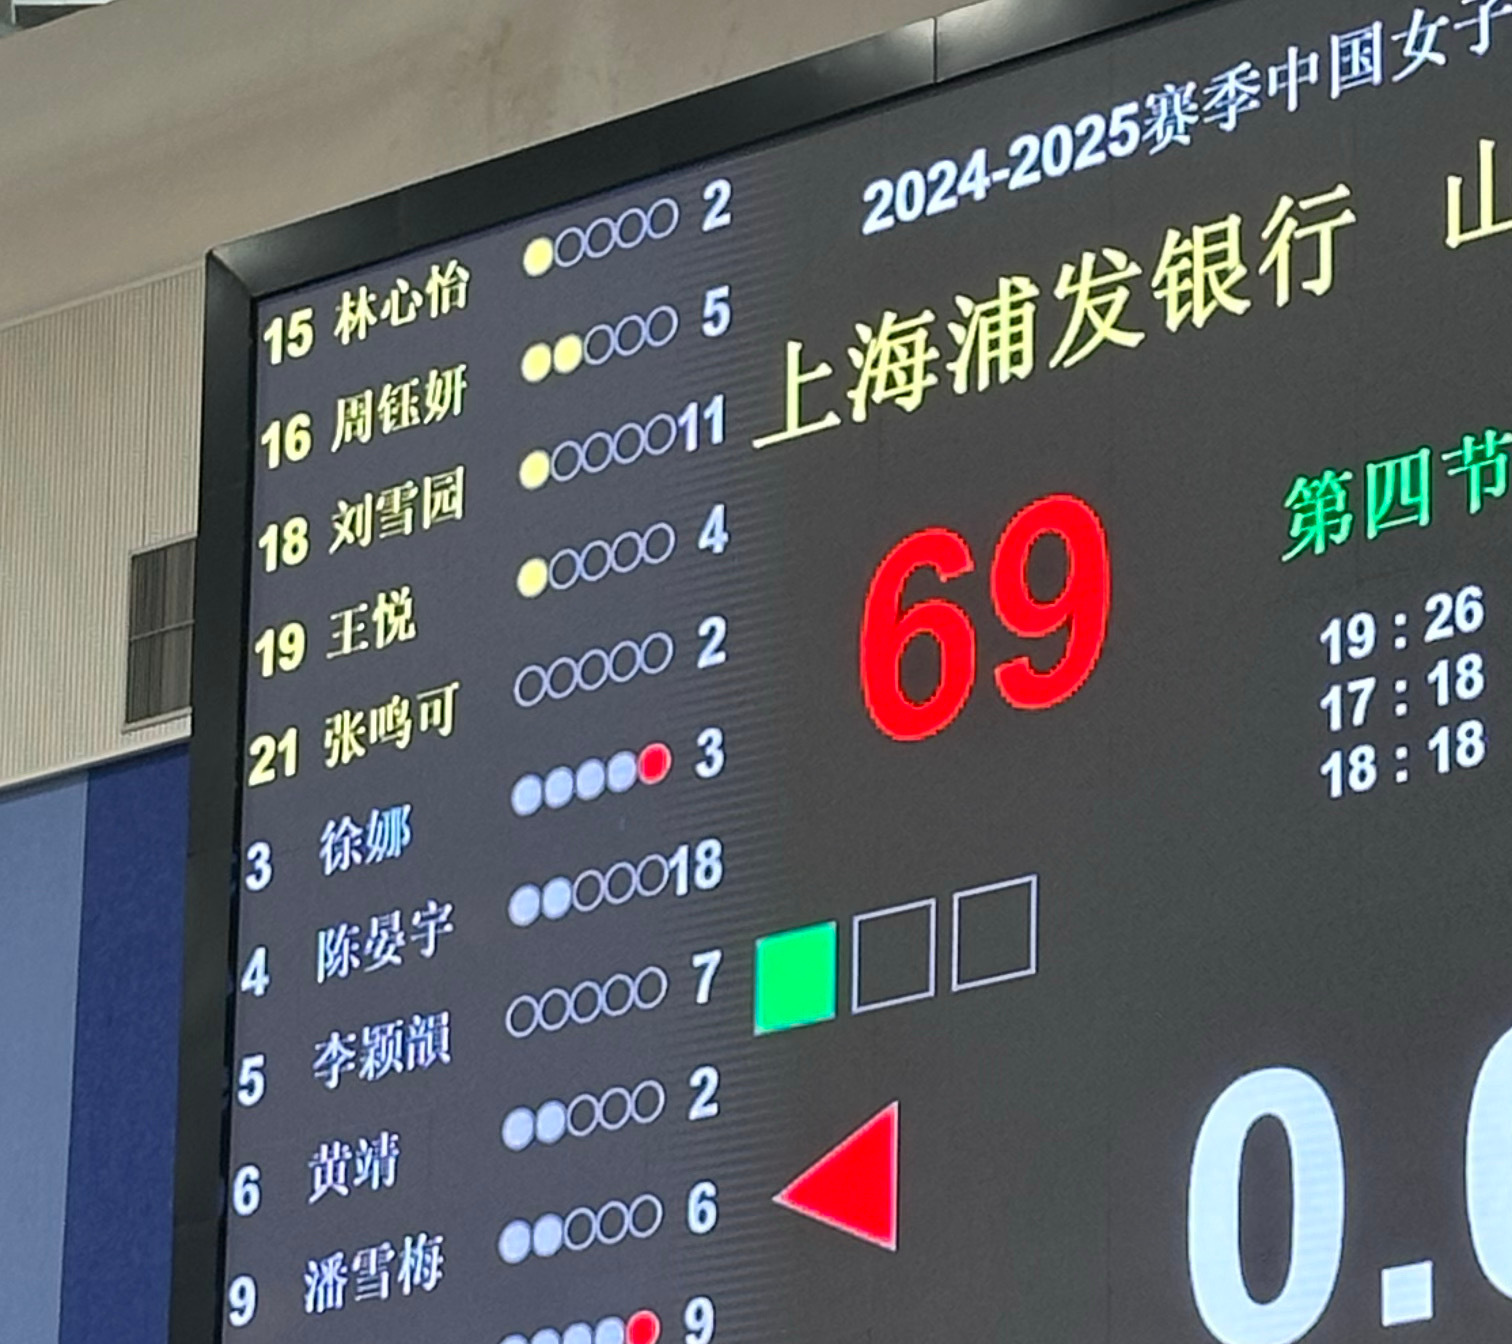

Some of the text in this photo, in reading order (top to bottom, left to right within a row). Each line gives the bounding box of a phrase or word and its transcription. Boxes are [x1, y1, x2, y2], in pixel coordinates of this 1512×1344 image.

[263, 178, 731, 365] 15 林心怡 2
[752, 178, 1357, 449] 上海浦发银行
[261, 285, 731, 469] 16 周钰妍 5
[258, 394, 724, 573] 18 刘雪园 11
[254, 503, 729, 678] 19 王悦 4
[859, 493, 1112, 742] 69
[248, 615, 726, 786] 21 张鸣可 2
[245, 727, 724, 891] 3 徐娜 3
[240, 947, 270, 997] 4
[666, 838, 723, 896] 18
[237, 1054, 265, 1106] 5
[692, 949, 722, 1004] 7
[232, 1066, 719, 1216] 6 黄靖 2
[228, 1181, 717, 1327] 9 潘雪梅 6
